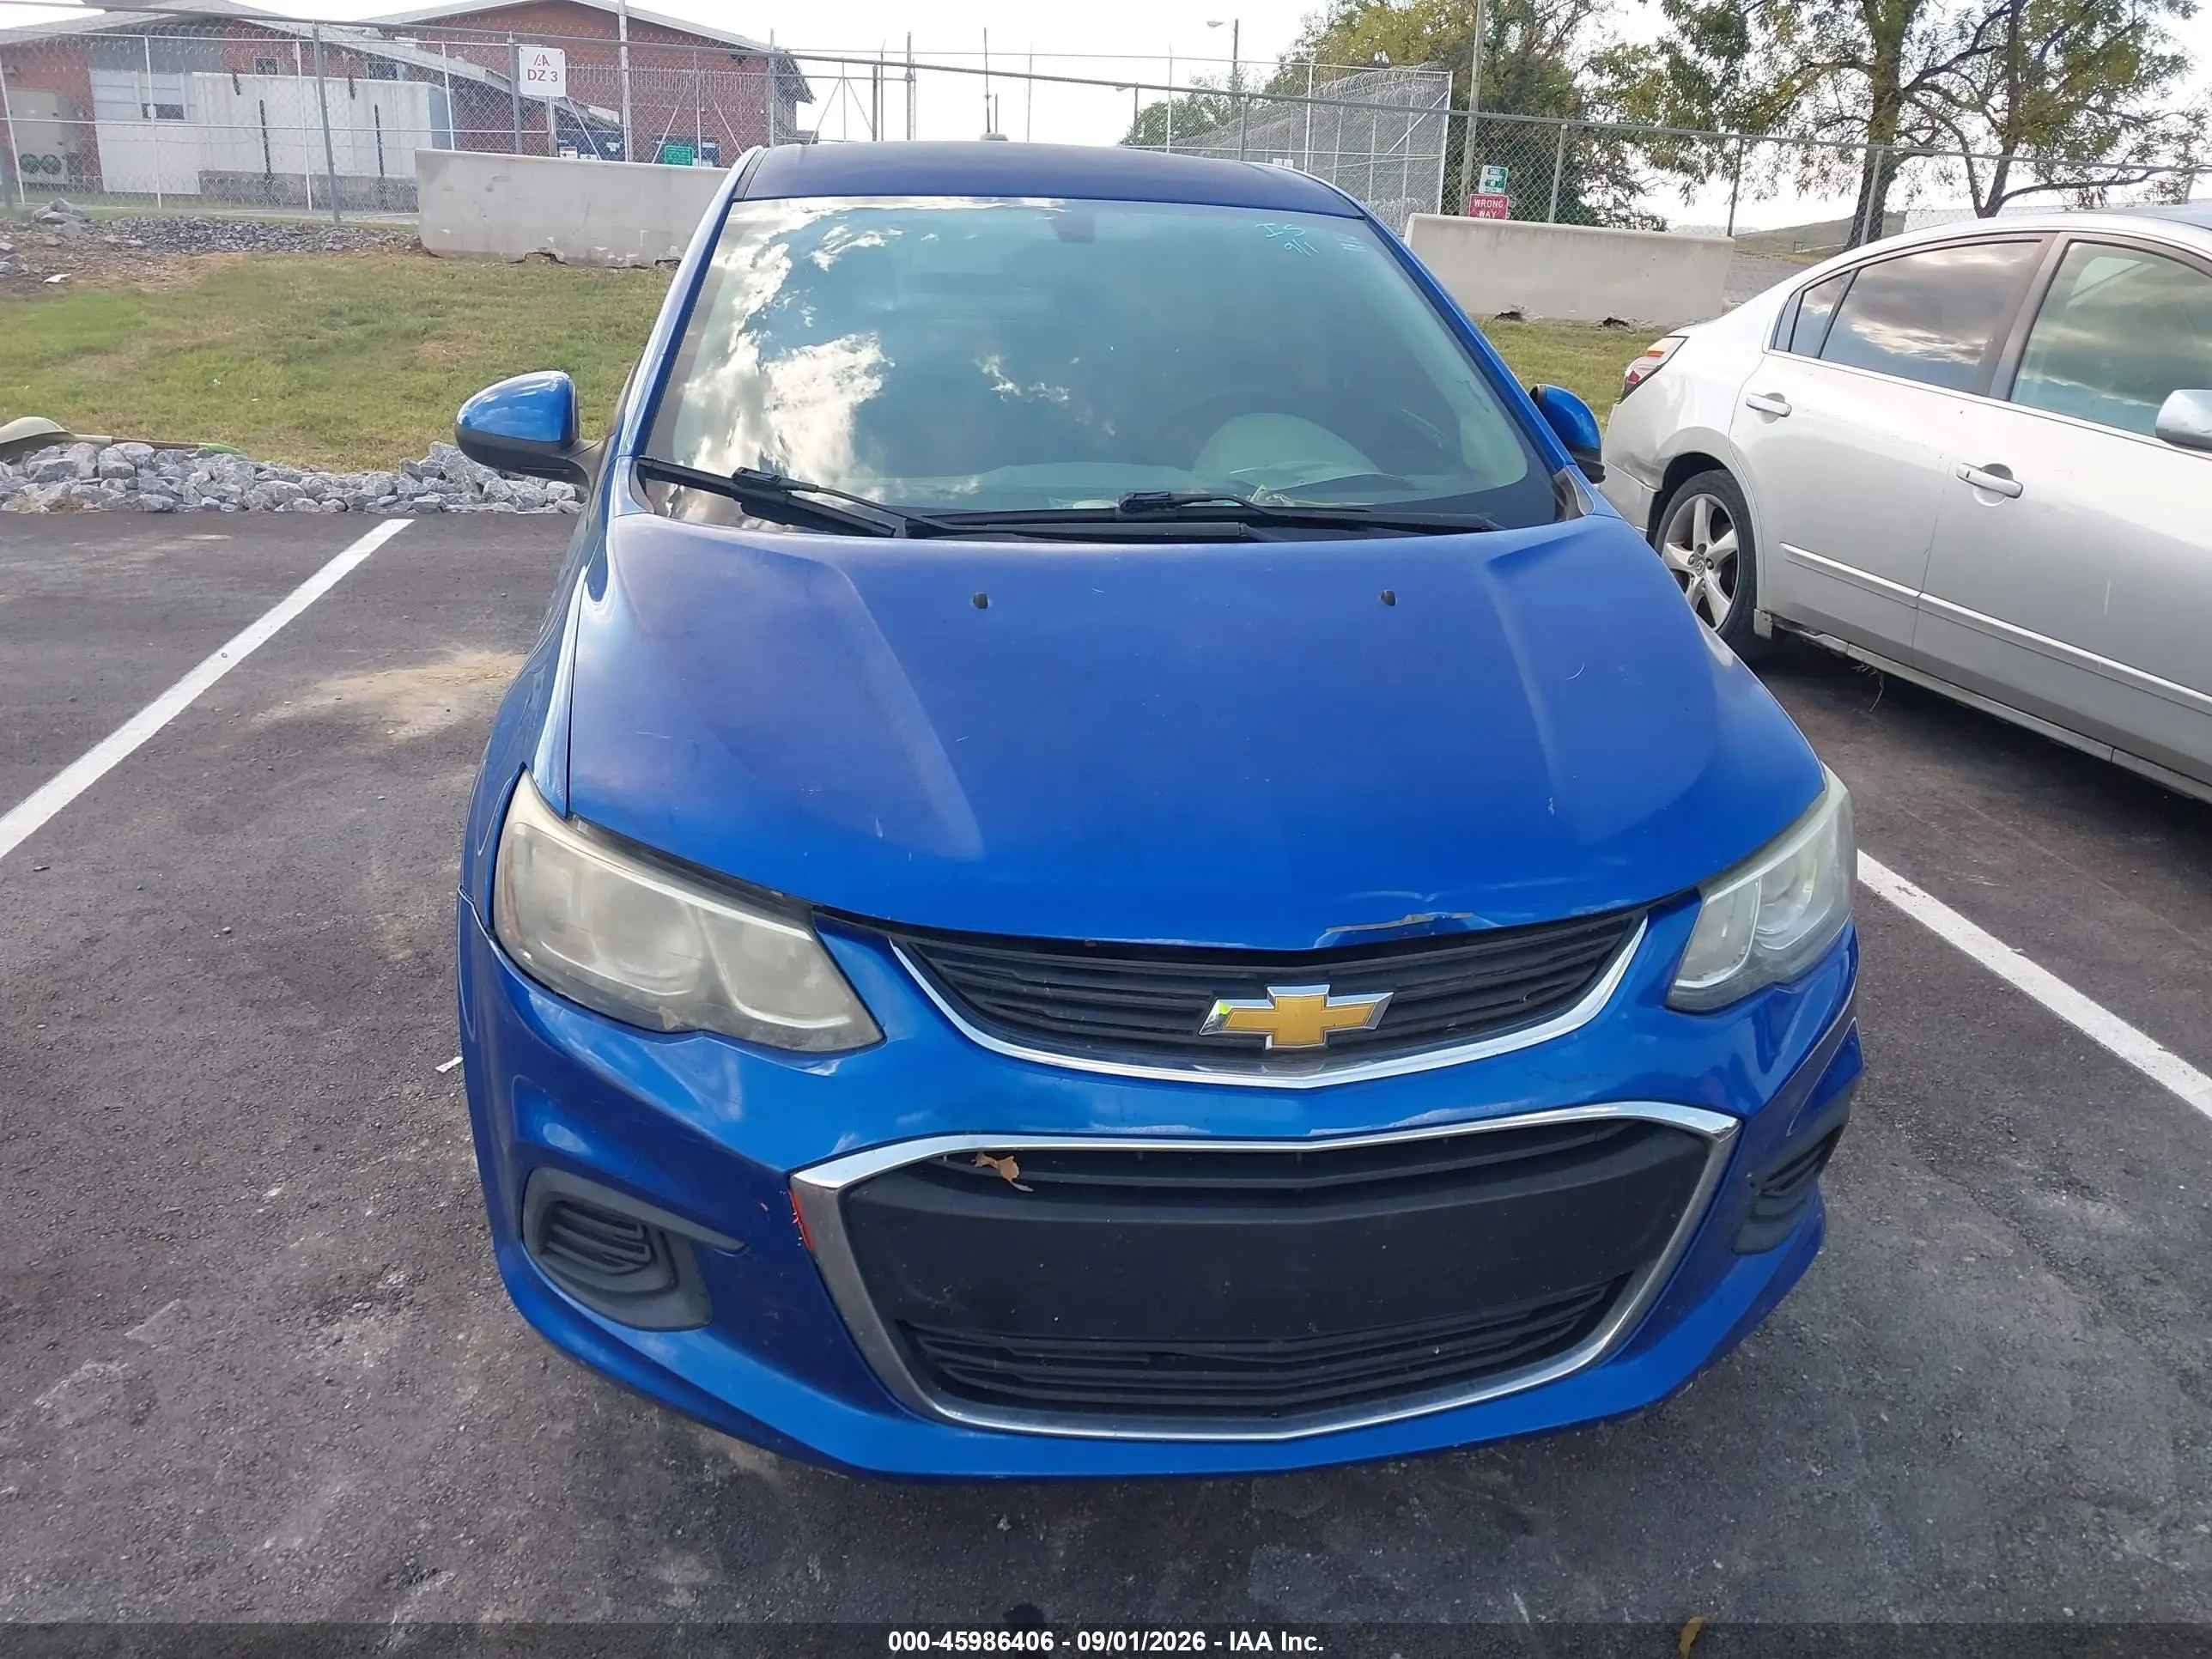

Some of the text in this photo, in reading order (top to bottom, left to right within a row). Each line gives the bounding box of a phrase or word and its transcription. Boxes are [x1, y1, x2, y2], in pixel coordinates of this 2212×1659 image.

[527, 69, 558, 82] DZ 3
[1474, 198, 1504, 209] WRONG
[1479, 210, 1498, 218] WAY
